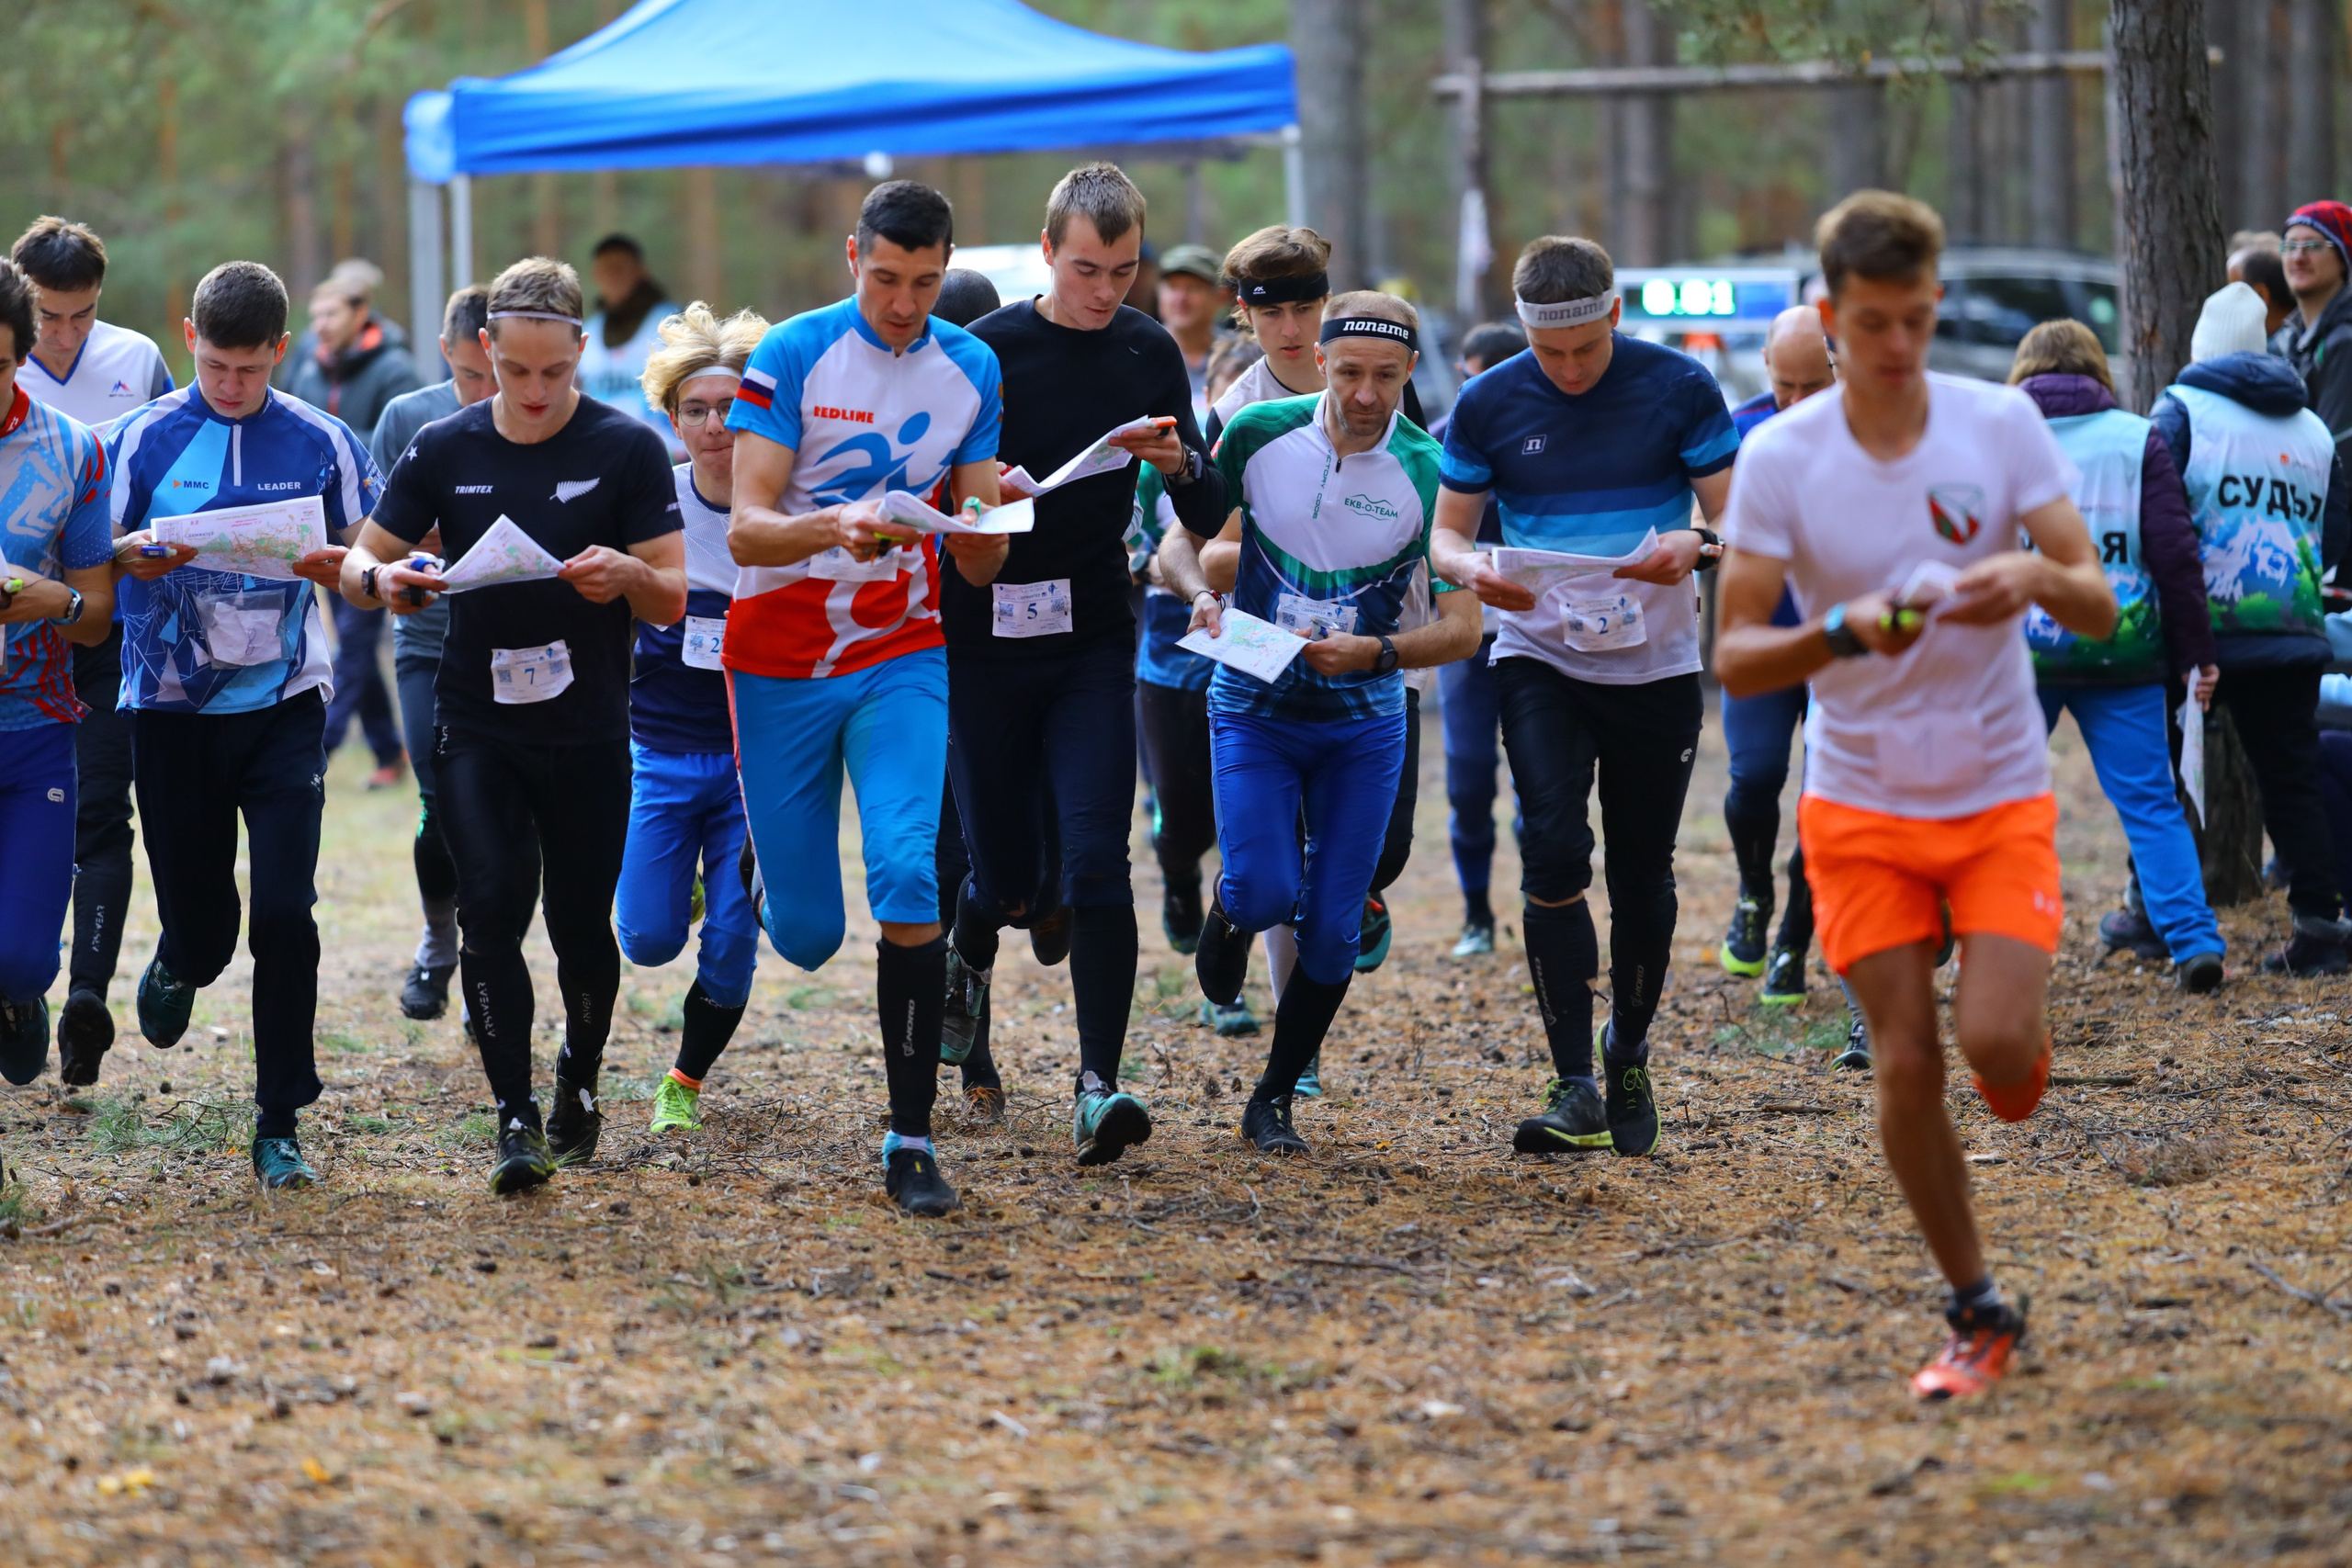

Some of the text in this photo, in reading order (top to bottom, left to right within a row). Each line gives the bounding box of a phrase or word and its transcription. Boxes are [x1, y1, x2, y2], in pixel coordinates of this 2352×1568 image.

[1537, 299, 1606, 321] noname
[1342, 320, 1409, 340] noname
[813, 405, 875, 424] REDLINE
[183, 479, 209, 490] MMC
[257, 481, 301, 491] LEADER
[455, 485, 493, 494] TRIMTEX
[1312, 448, 1332, 520] VICTORY CODE
[1344, 497, 1398, 518] EKB-O-TEAM
[1026, 602, 1038, 620] 5
[1598, 616, 1610, 635] 2
[525, 667, 535, 685] 7
